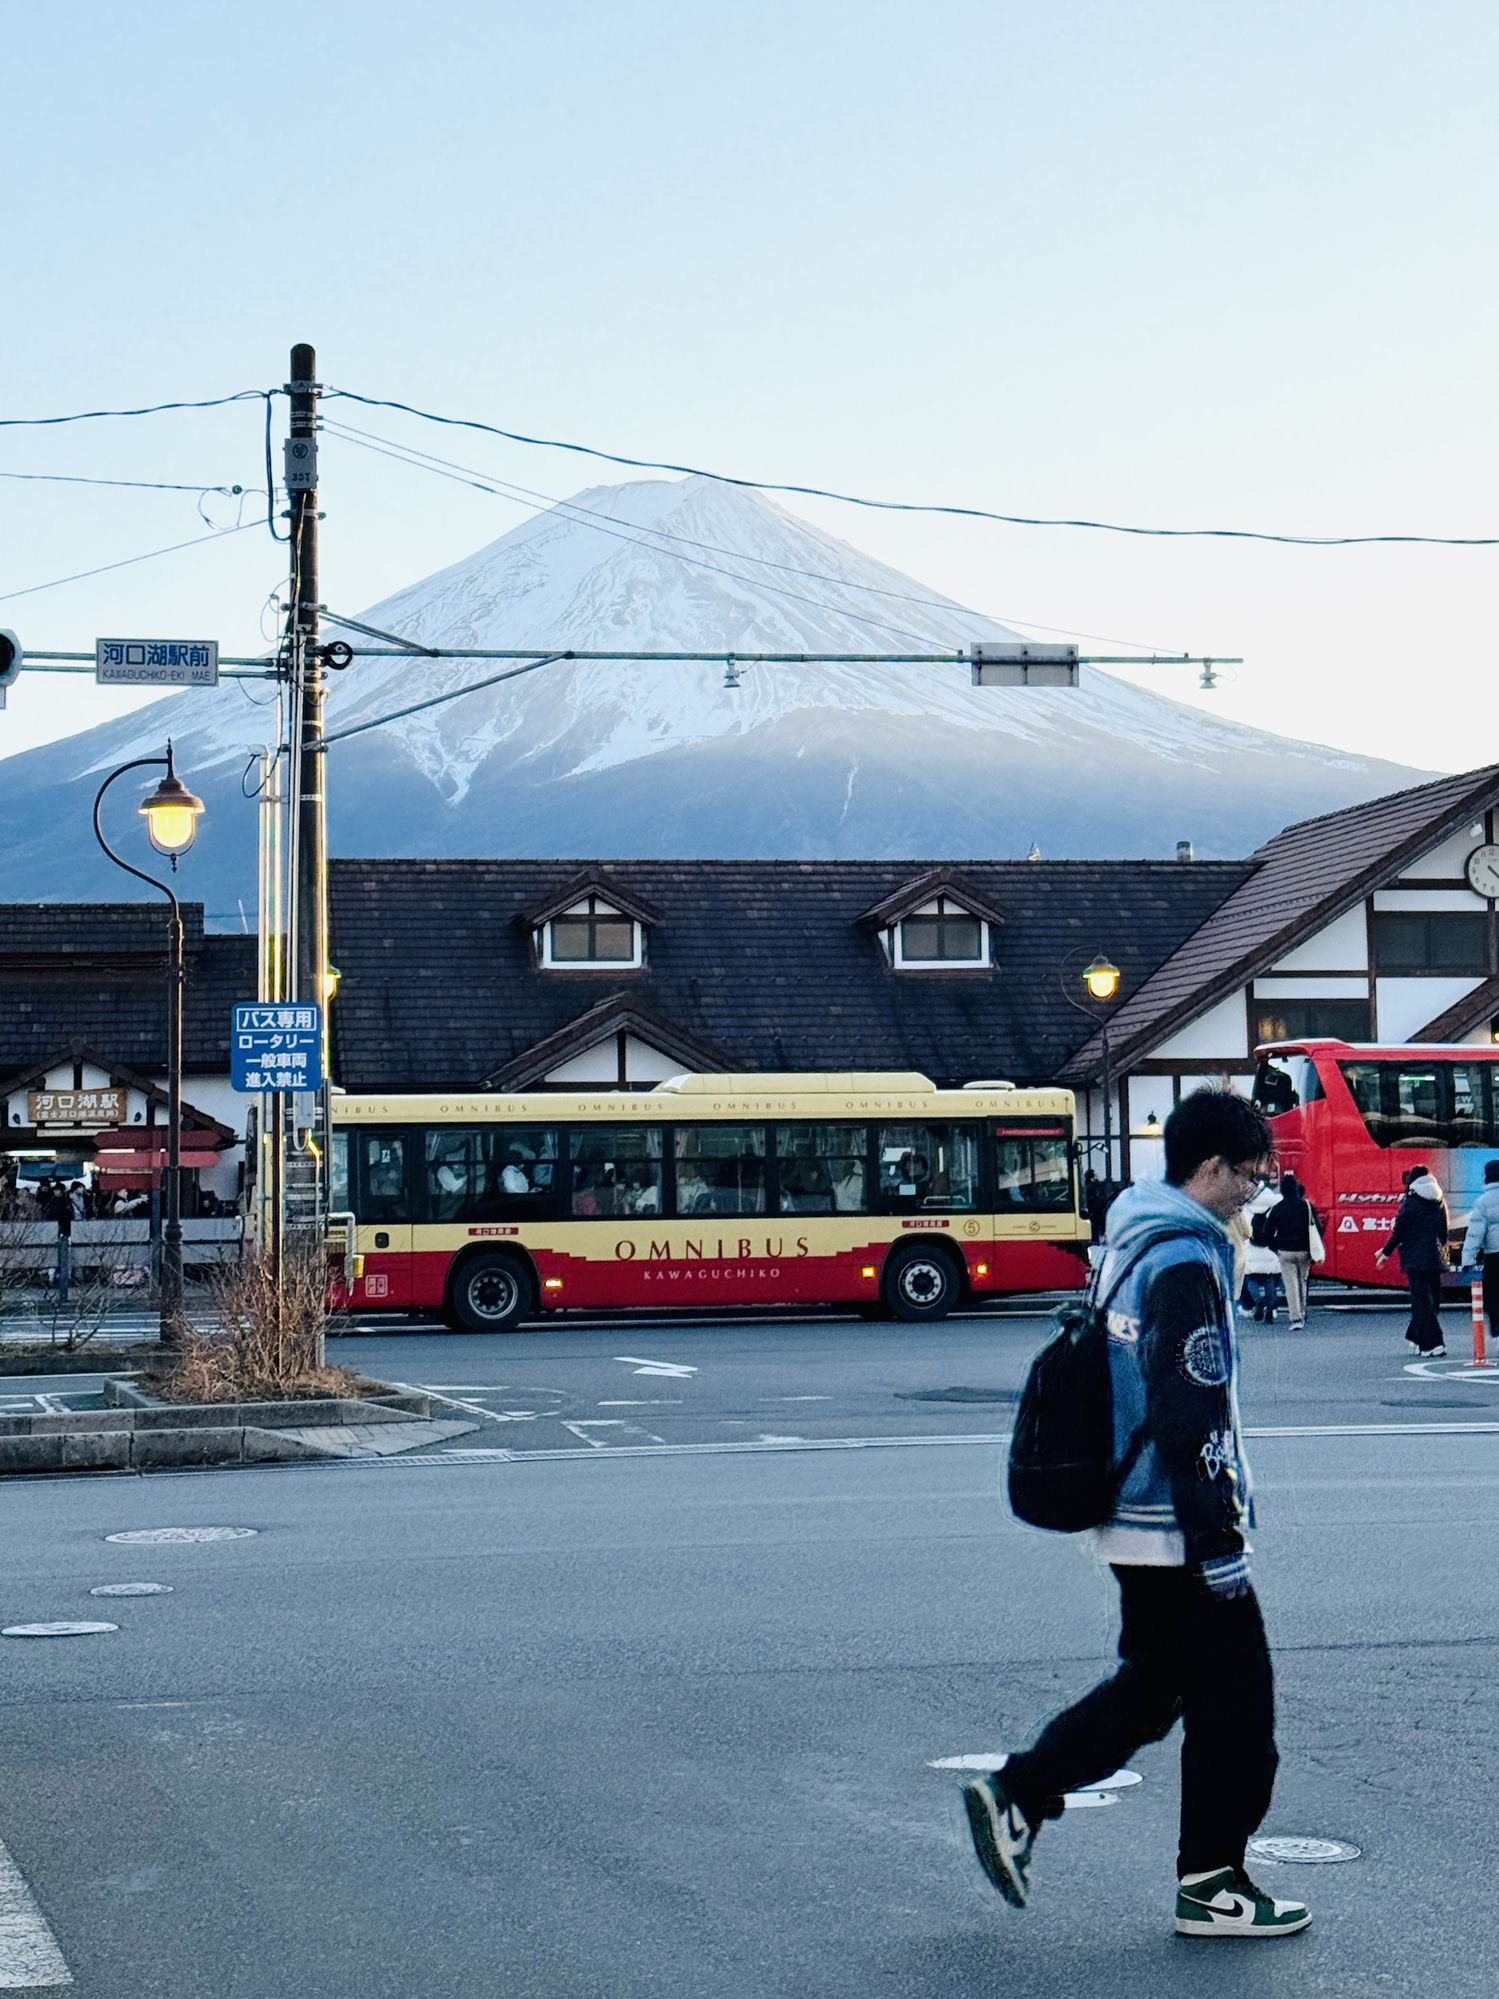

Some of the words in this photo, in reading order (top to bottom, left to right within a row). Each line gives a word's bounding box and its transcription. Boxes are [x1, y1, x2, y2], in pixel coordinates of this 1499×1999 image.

[103, 643, 210, 667] 河口湖駅前
[191, 670, 211, 681] MAE
[241, 1010, 312, 1029] バス専用
[238, 1034, 315, 1049] ロータリー
[245, 1052, 307, 1069] 一般車両
[245, 1071, 308, 1088] 進入禁止
[35, 1093, 120, 1110] 河口湖駅
[577, 1103, 664, 1112] OMNIBUS
[713, 1102, 797, 1111] OMNIBUS
[845, 1101, 928, 1109] OMNIBUS
[975, 1100, 1057, 1109] OMNIBUS
[331, 1106, 388, 1114] NIBUS
[439, 1104, 528, 1113] OMNIBUS
[1337, 1192, 1407, 1204] Hybri
[614, 1236, 809, 1261] OMNIBUS
[643, 1268, 781, 1280] KAWAGUCHIKO
